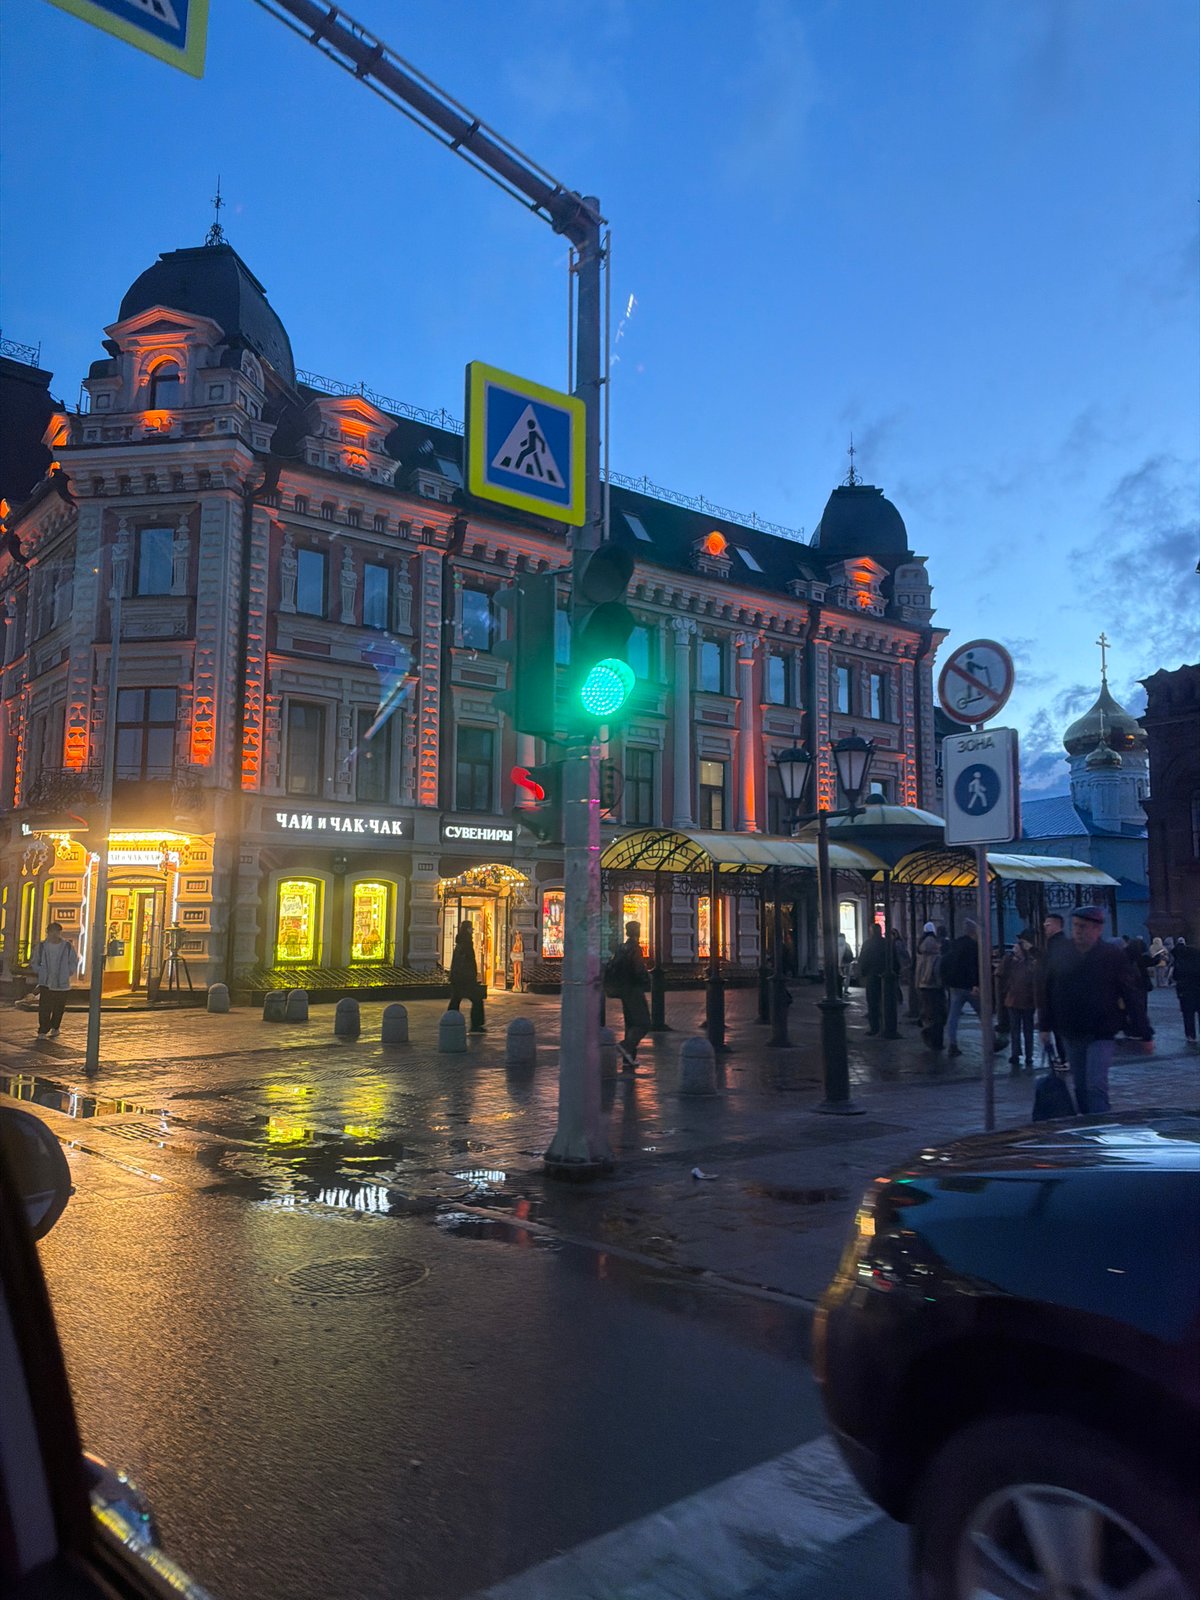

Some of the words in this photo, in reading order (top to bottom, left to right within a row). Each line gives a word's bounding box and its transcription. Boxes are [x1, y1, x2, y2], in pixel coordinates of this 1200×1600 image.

[957, 736, 995, 753] ЗОНА
[276, 813, 313, 829] ЧАЙ
[445, 826, 513, 841] СУВЕНИРЫ
